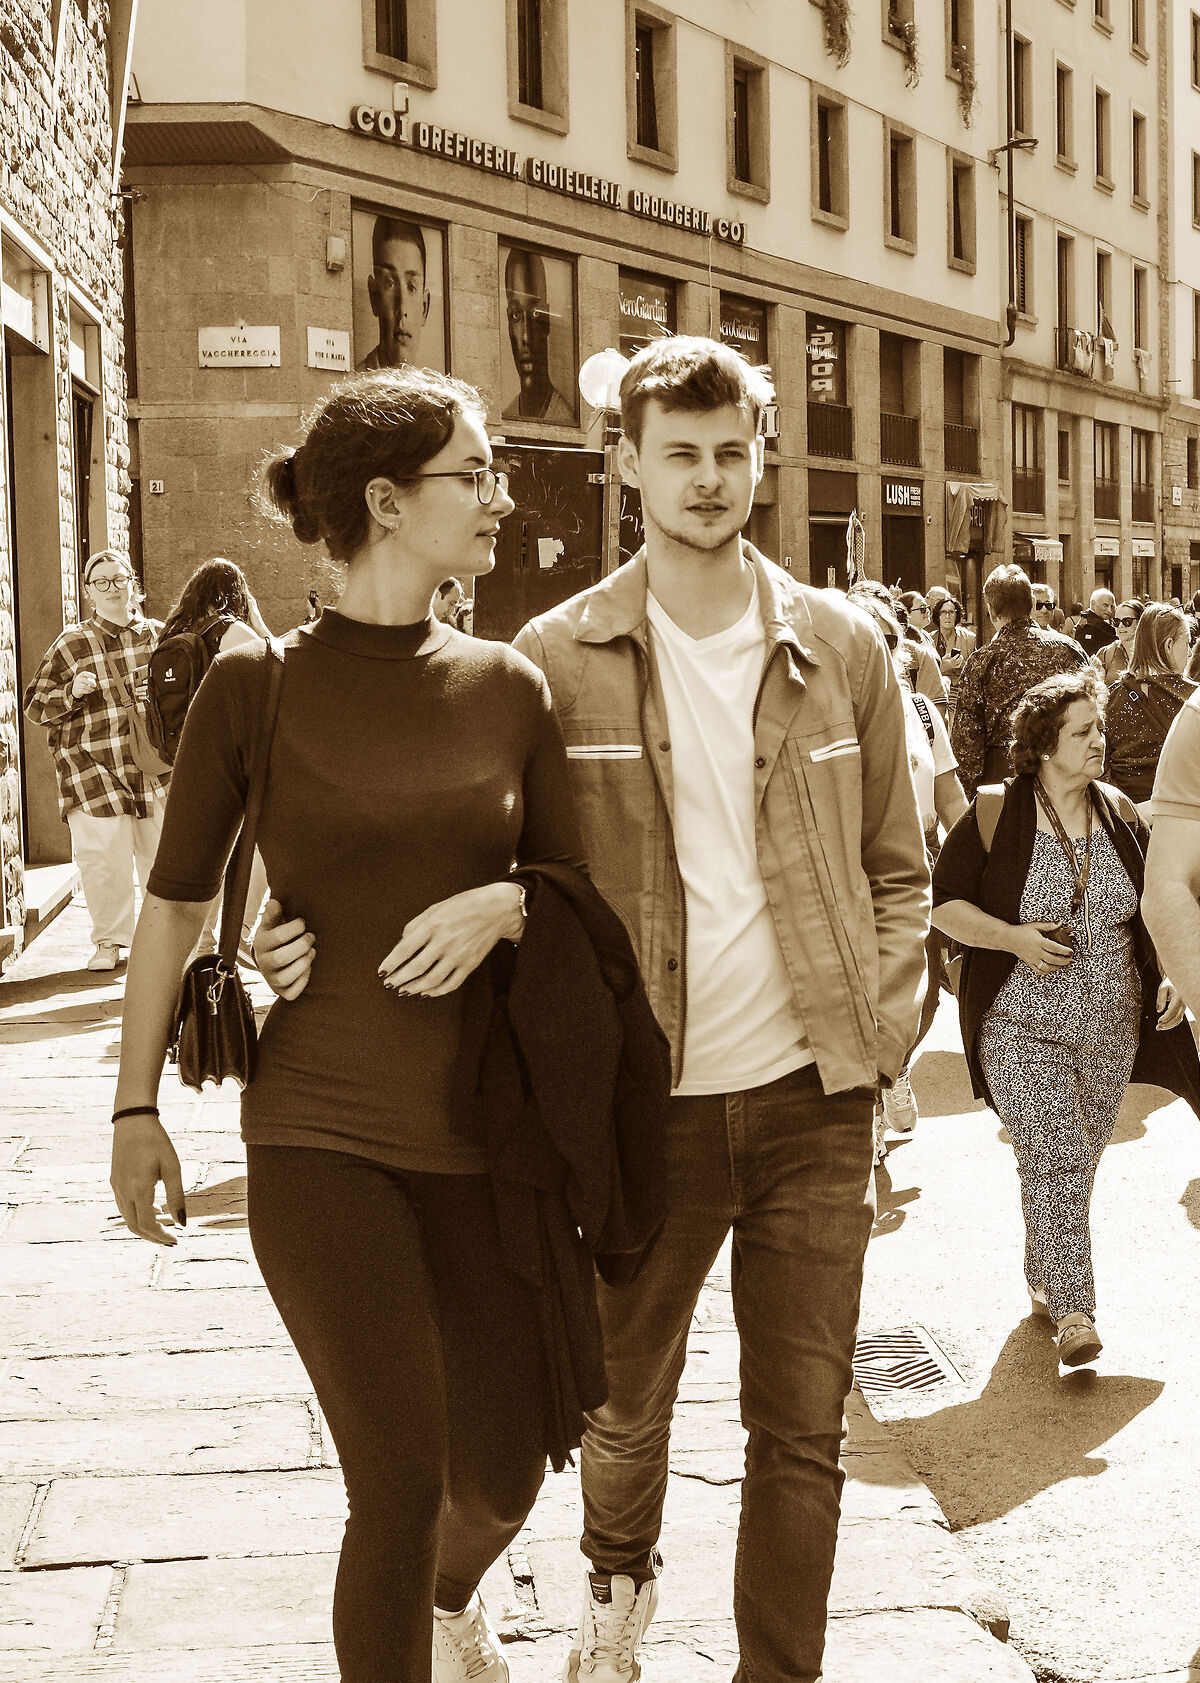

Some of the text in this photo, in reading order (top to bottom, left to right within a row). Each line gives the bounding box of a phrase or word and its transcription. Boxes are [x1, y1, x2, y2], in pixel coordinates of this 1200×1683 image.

[354, 104, 749, 243] COI OREFICERIA GIOIELLERIA OROLOGERIA COI
[152, 482, 161, 492] 21
[886, 484, 910, 506] LUSH
[913, 697, 932, 730] BIMBA
